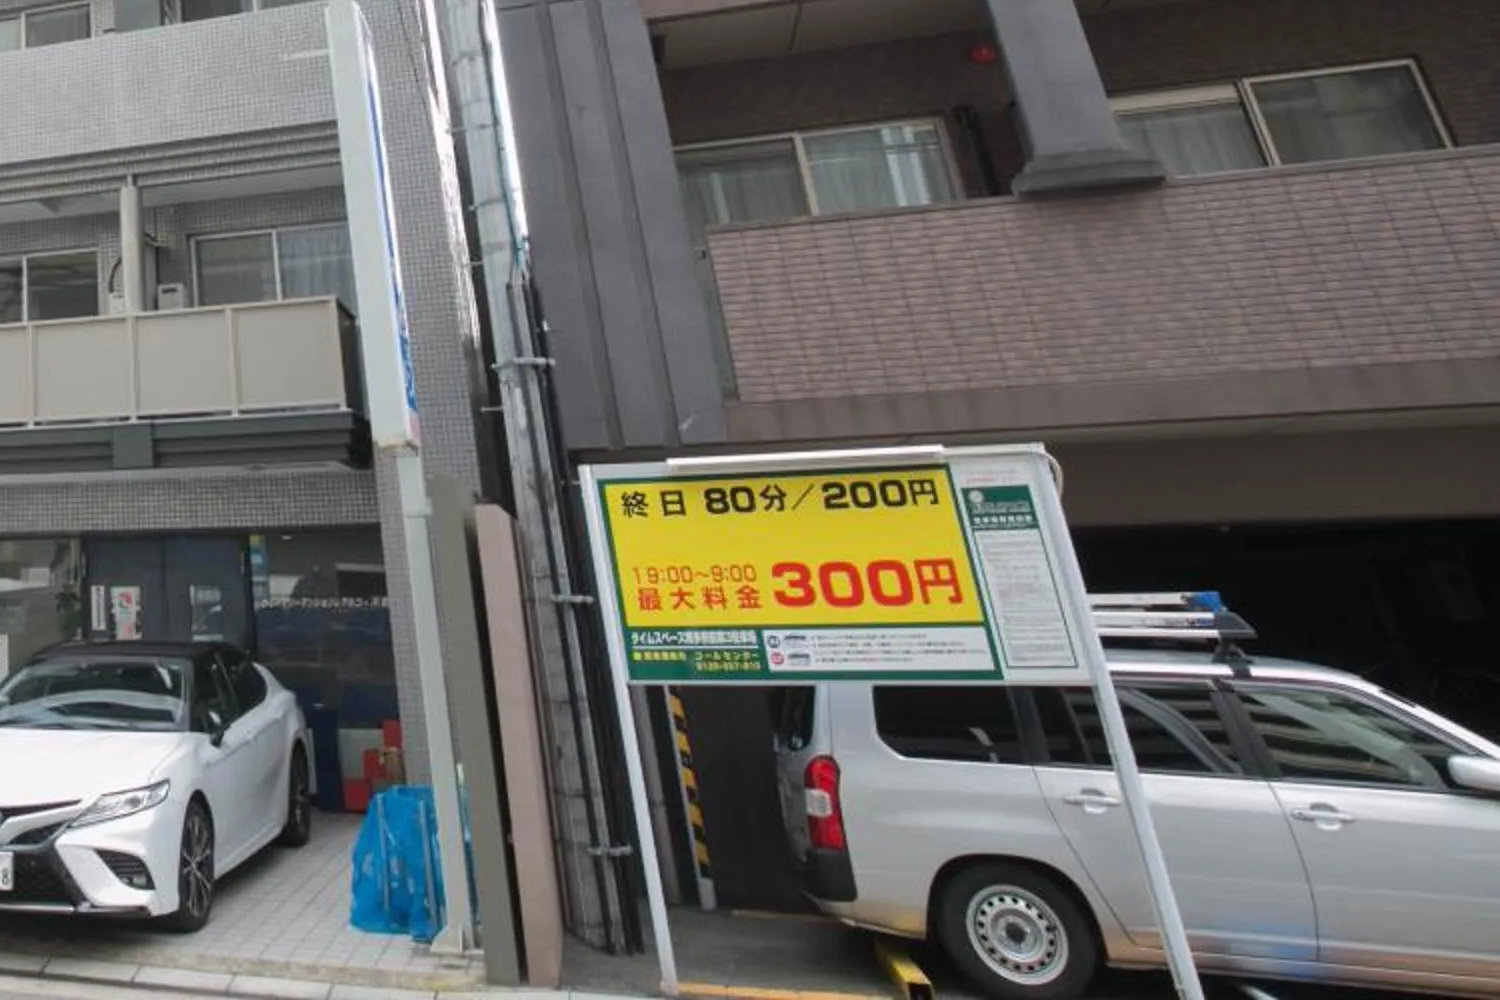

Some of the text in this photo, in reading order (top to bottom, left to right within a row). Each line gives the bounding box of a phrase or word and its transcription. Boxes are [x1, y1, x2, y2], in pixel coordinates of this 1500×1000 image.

[621, 490, 687, 517] 終日
[771, 557, 965, 609] 300円
[638, 584, 764, 610] 最大料金
